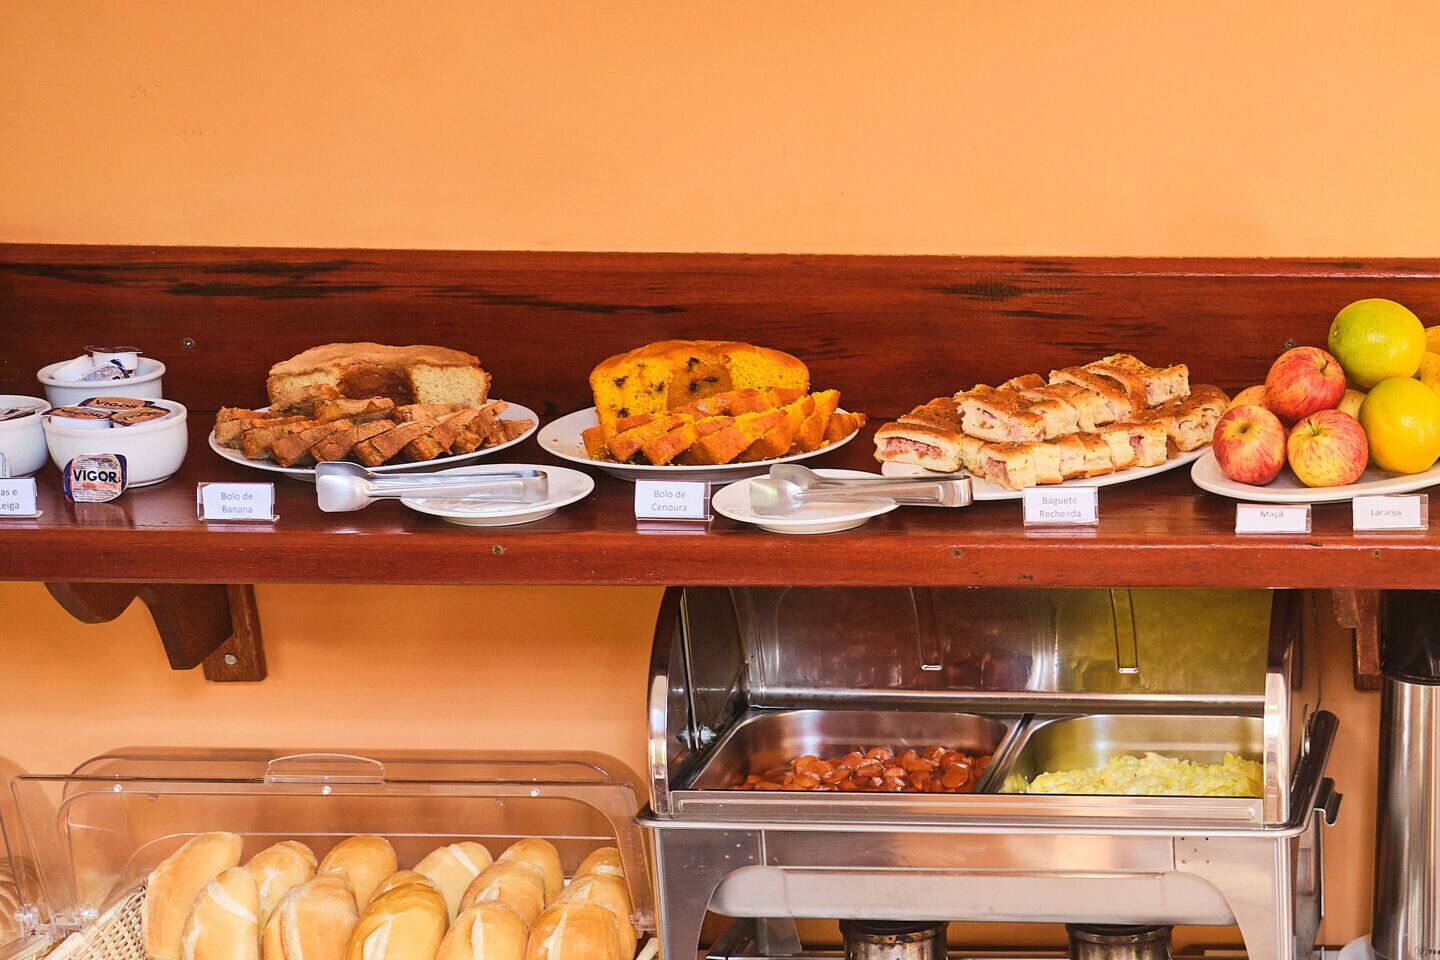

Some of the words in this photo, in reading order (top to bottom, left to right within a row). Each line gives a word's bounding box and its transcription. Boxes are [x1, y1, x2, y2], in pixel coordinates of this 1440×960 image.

[73, 469, 119, 483] VIGOR
[221, 492, 241, 500] Bolo
[242, 491, 254, 500] de
[654, 490, 673, 498] Bolo
[675, 489, 687, 498] de
[1042, 496, 1078, 506] Baguete
[222, 505, 253, 514] Banana
[651, 502, 688, 511] Cenoura
[1039, 509, 1081, 518] Recheada
[1260, 510, 1284, 519] Maçã
[1370, 509, 1402, 518] Laranja
